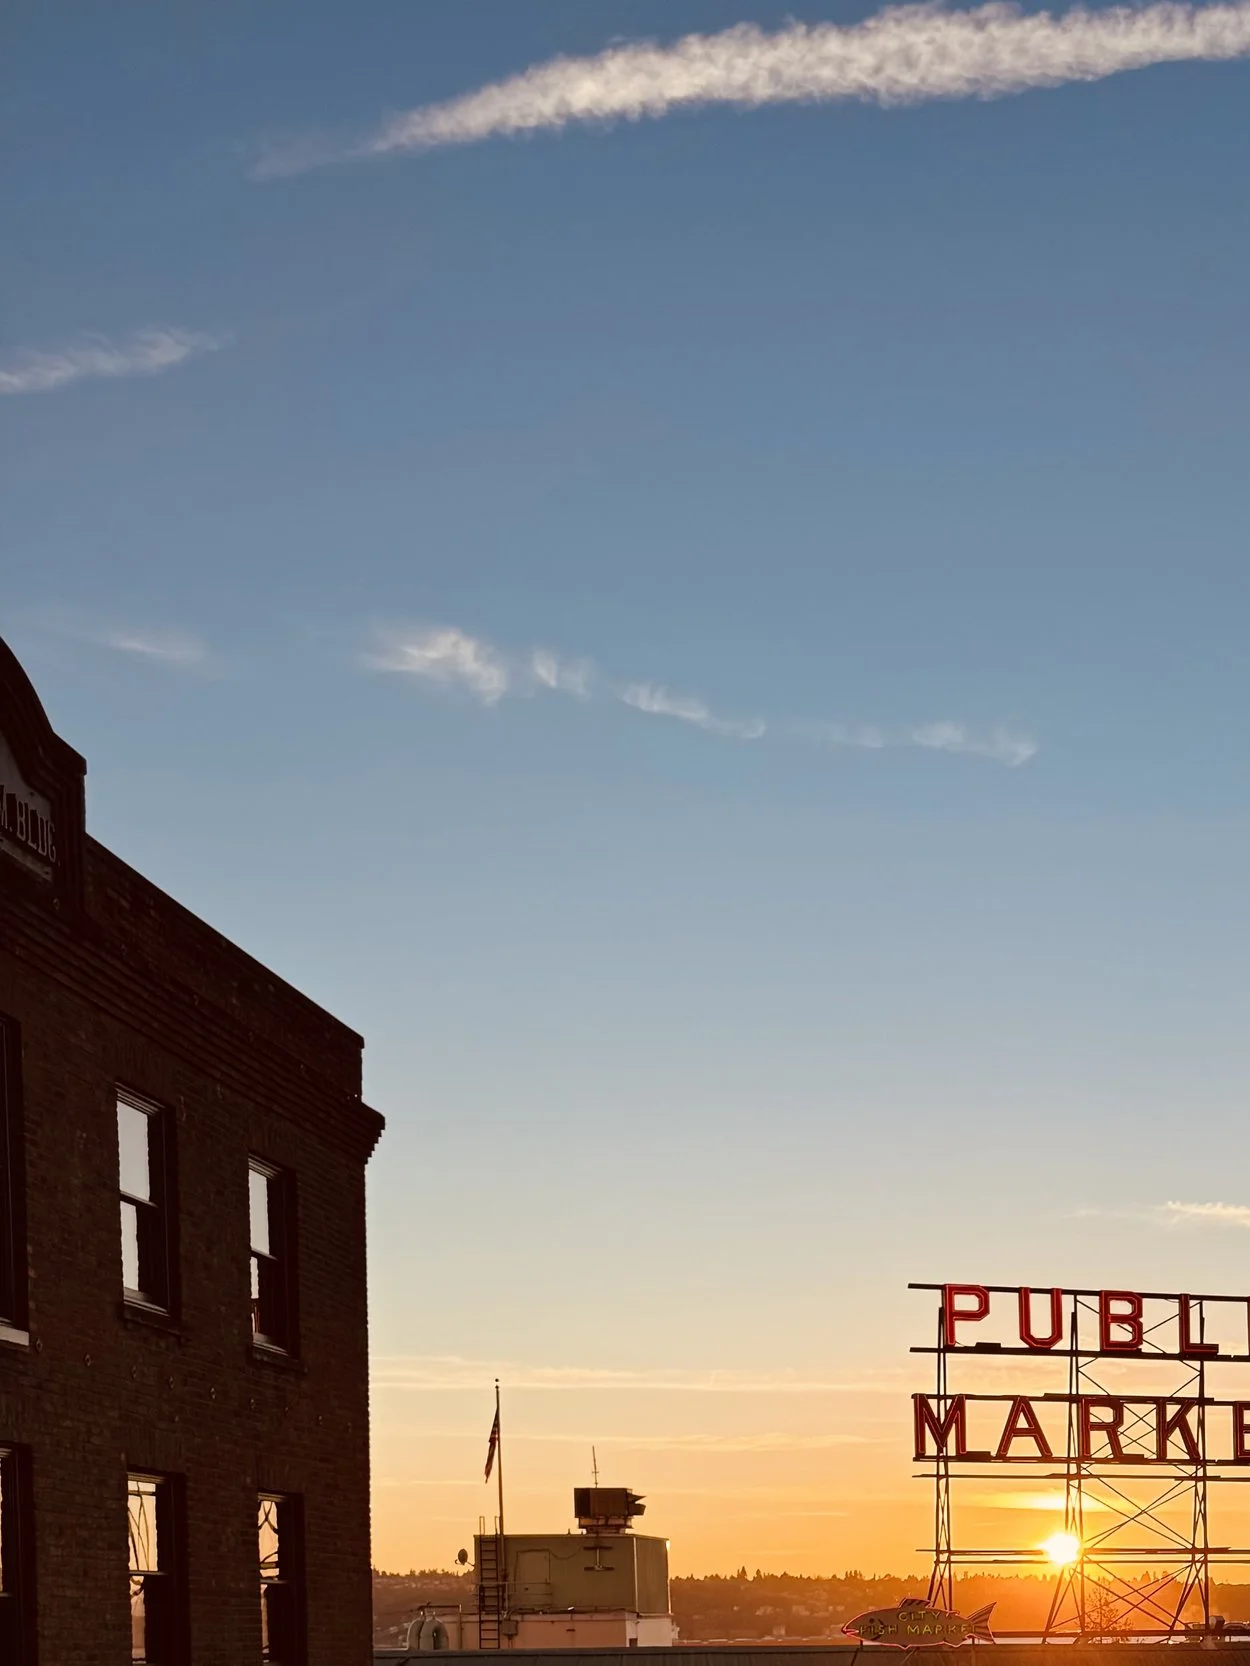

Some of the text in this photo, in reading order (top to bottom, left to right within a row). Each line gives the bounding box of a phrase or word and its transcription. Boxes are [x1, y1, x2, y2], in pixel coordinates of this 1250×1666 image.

[898, 1610, 941, 1622] CITY
[859, 1624, 976, 1636] FISH MARKET
